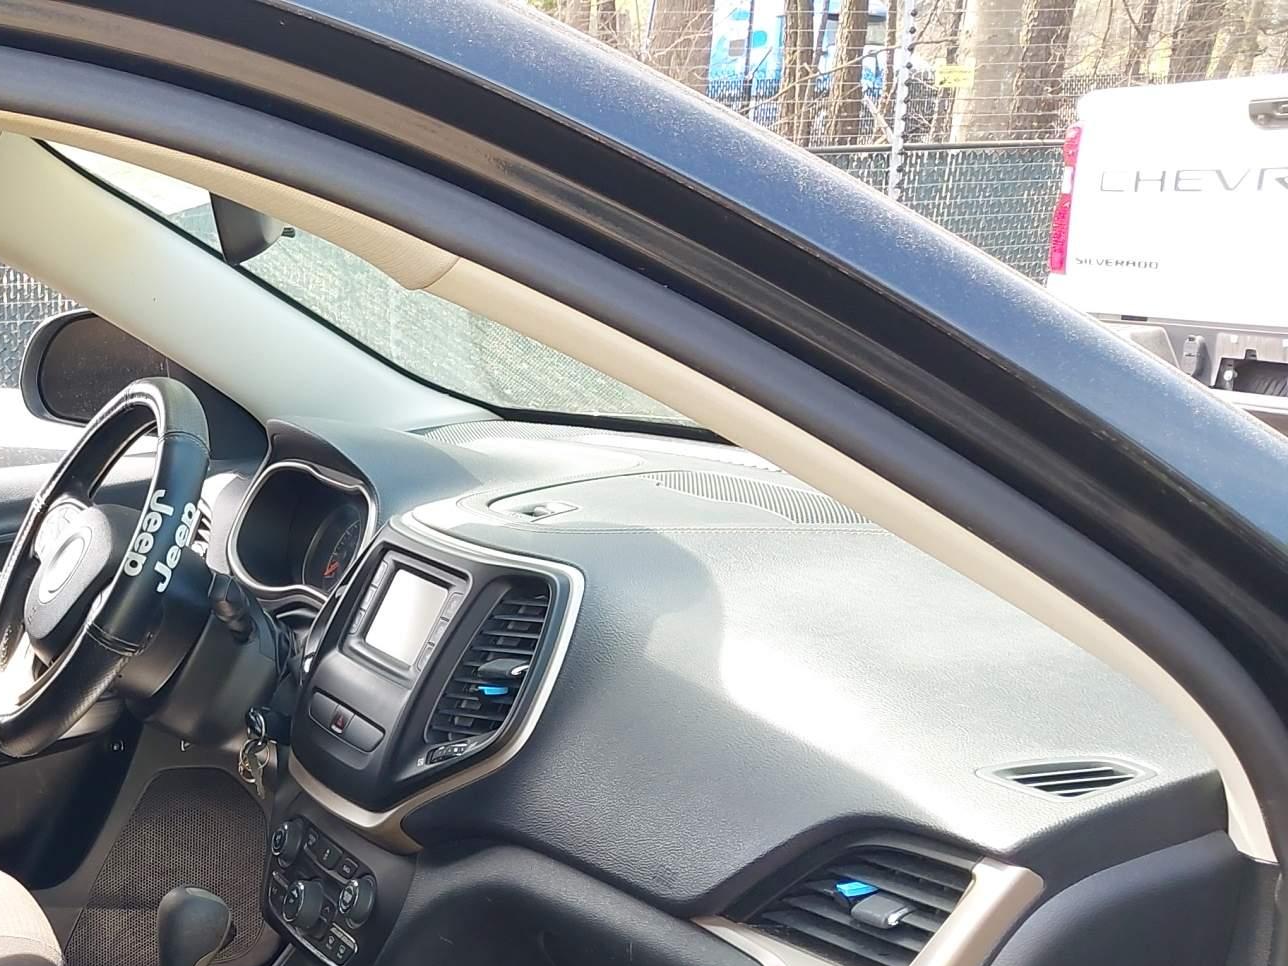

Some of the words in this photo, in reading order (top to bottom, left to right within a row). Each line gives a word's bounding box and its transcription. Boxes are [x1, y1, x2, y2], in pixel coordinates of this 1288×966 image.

[1075, 256, 1159, 271] SILVERADO
[123, 489, 174, 577] Jeep
[154, 502, 198, 593] Jeep
